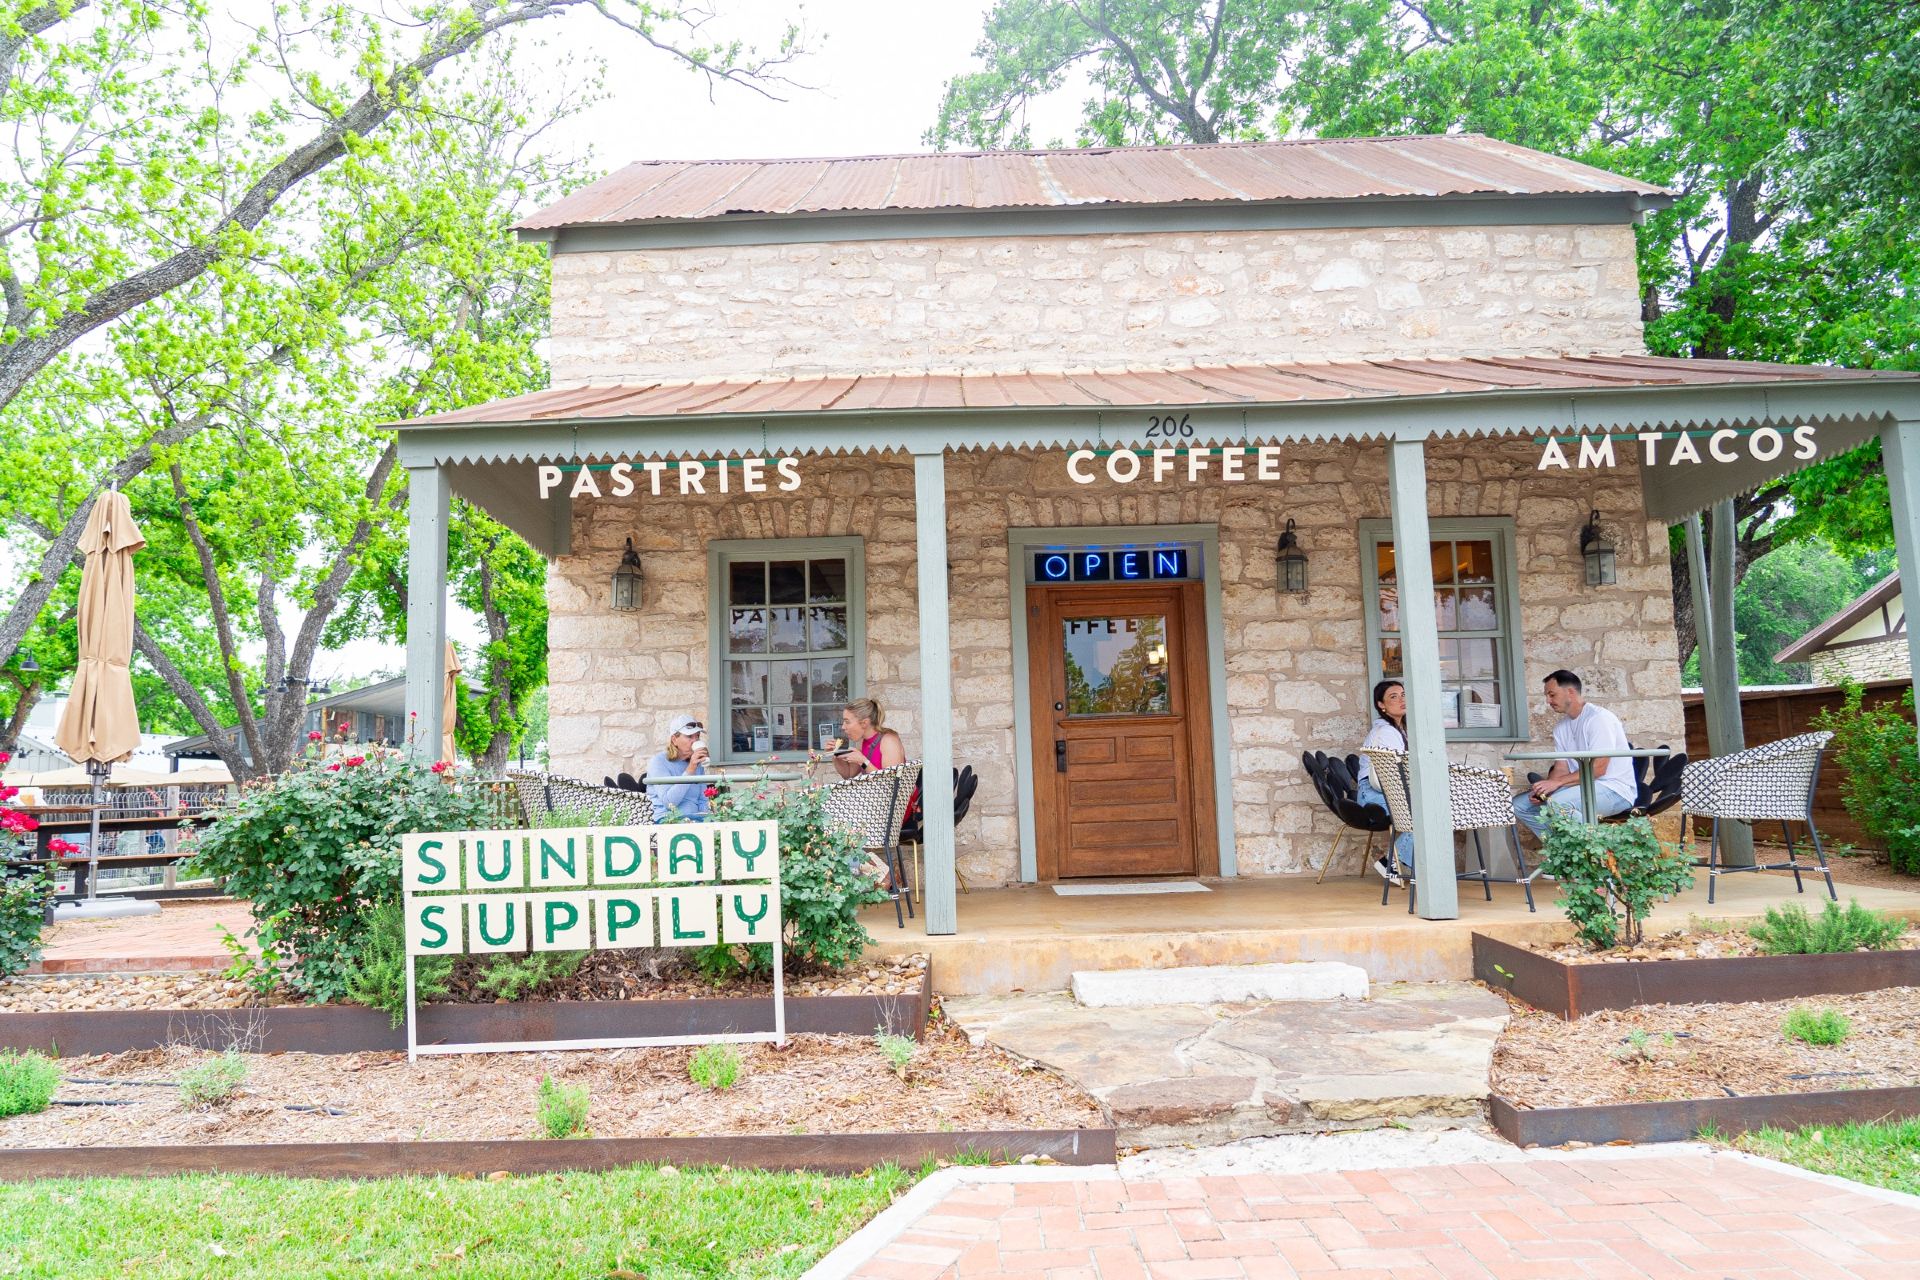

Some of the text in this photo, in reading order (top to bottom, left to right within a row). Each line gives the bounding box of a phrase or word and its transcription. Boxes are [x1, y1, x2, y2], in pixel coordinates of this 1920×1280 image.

[1145, 413, 1194, 438] 206
[1066, 446, 1282, 484] COFFEE
[1537, 425, 1817, 470] AM TACOS
[538, 457, 802, 500] PASTRIES
[1045, 552, 1178, 577] OPEN
[417, 829, 767, 885] SUNDAY
[420, 893, 768, 949] SUPPLY
